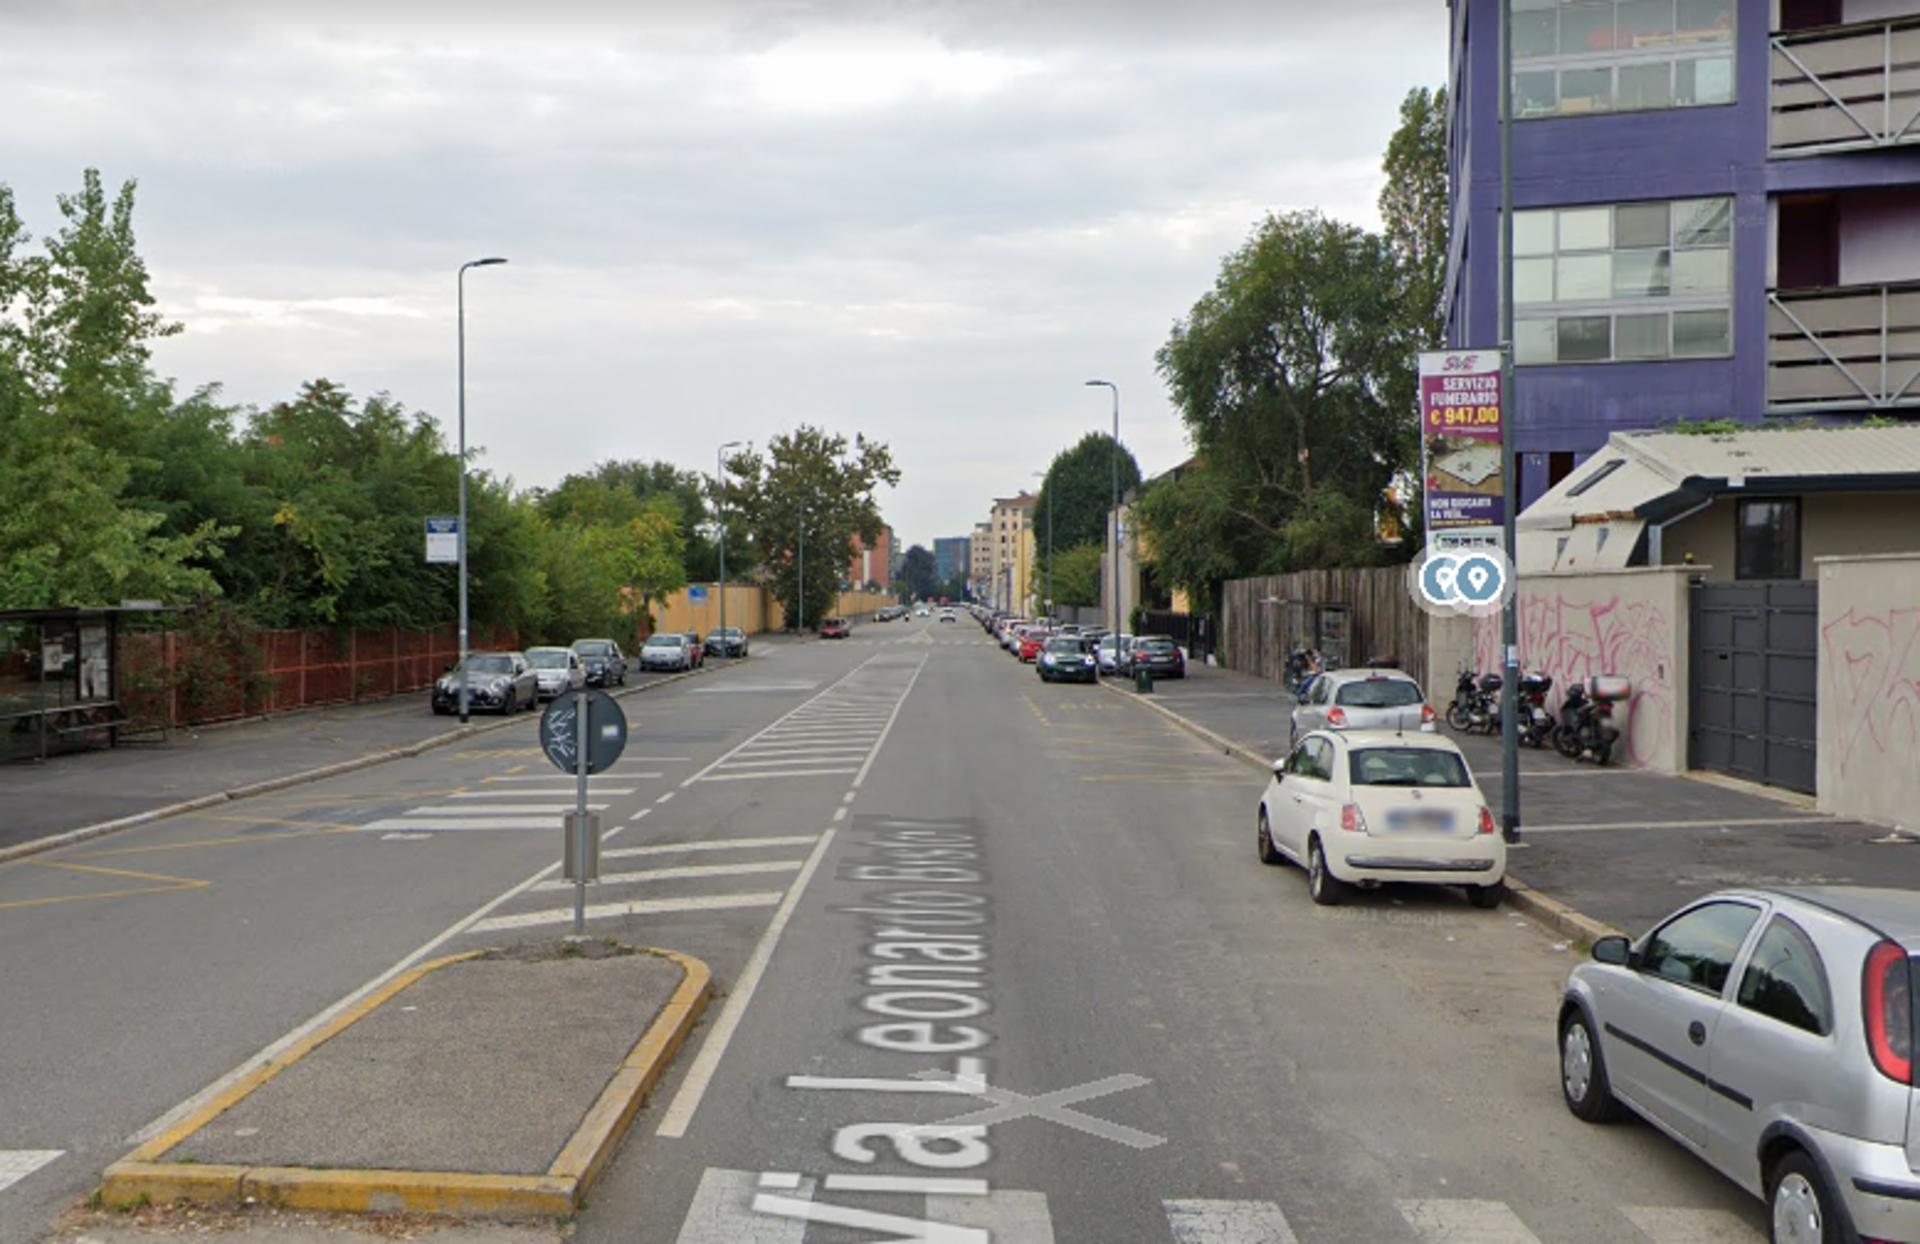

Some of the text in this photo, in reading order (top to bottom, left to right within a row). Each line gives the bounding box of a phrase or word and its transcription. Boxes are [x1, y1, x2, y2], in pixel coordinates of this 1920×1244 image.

[1443, 376, 1497, 390] SERVIZIO
[1431, 391, 1498, 406] FUNERARIO
[1431, 406, 1499, 426] € 947,00
[1431, 509, 1442, 519] LA
